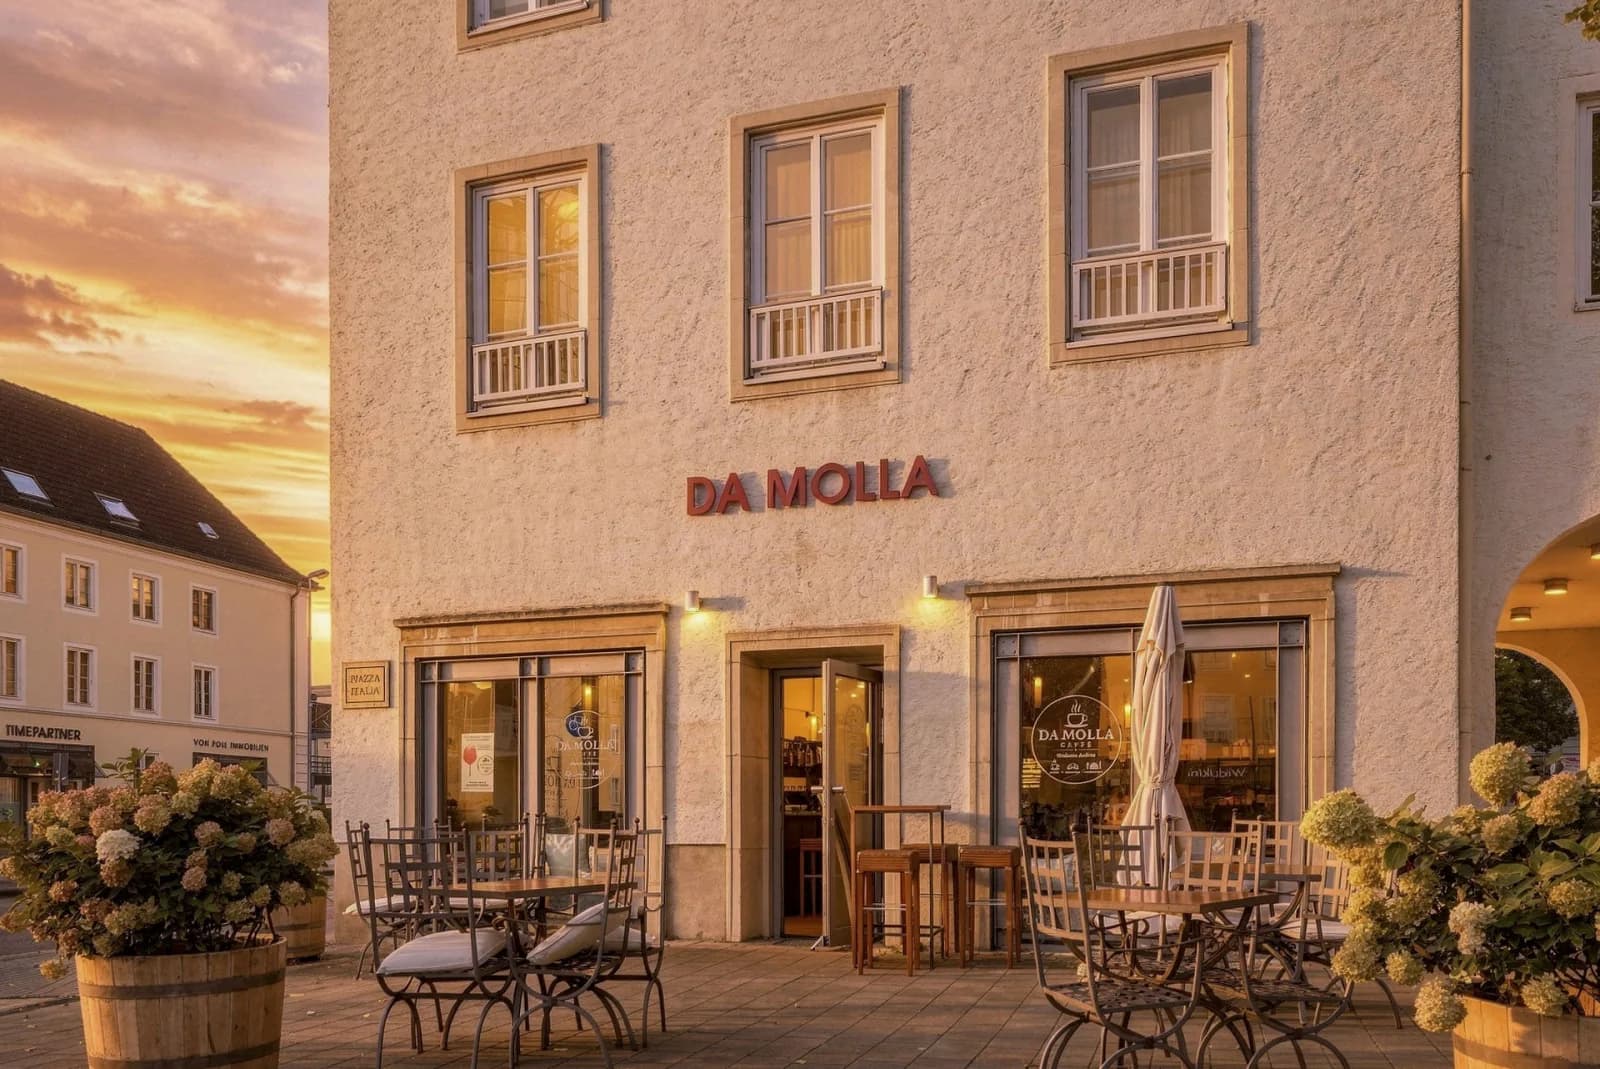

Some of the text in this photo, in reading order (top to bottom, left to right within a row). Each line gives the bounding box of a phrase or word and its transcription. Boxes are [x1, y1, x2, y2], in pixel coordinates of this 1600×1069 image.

[686, 455, 939, 516] DA MOLLA
[350, 674, 380, 683] PIAZZA
[350, 687, 380, 696] ITALIA
[6, 724, 81, 740] TIMEPARTNER
[1039, 728, 1114, 741] DA MOLLA
